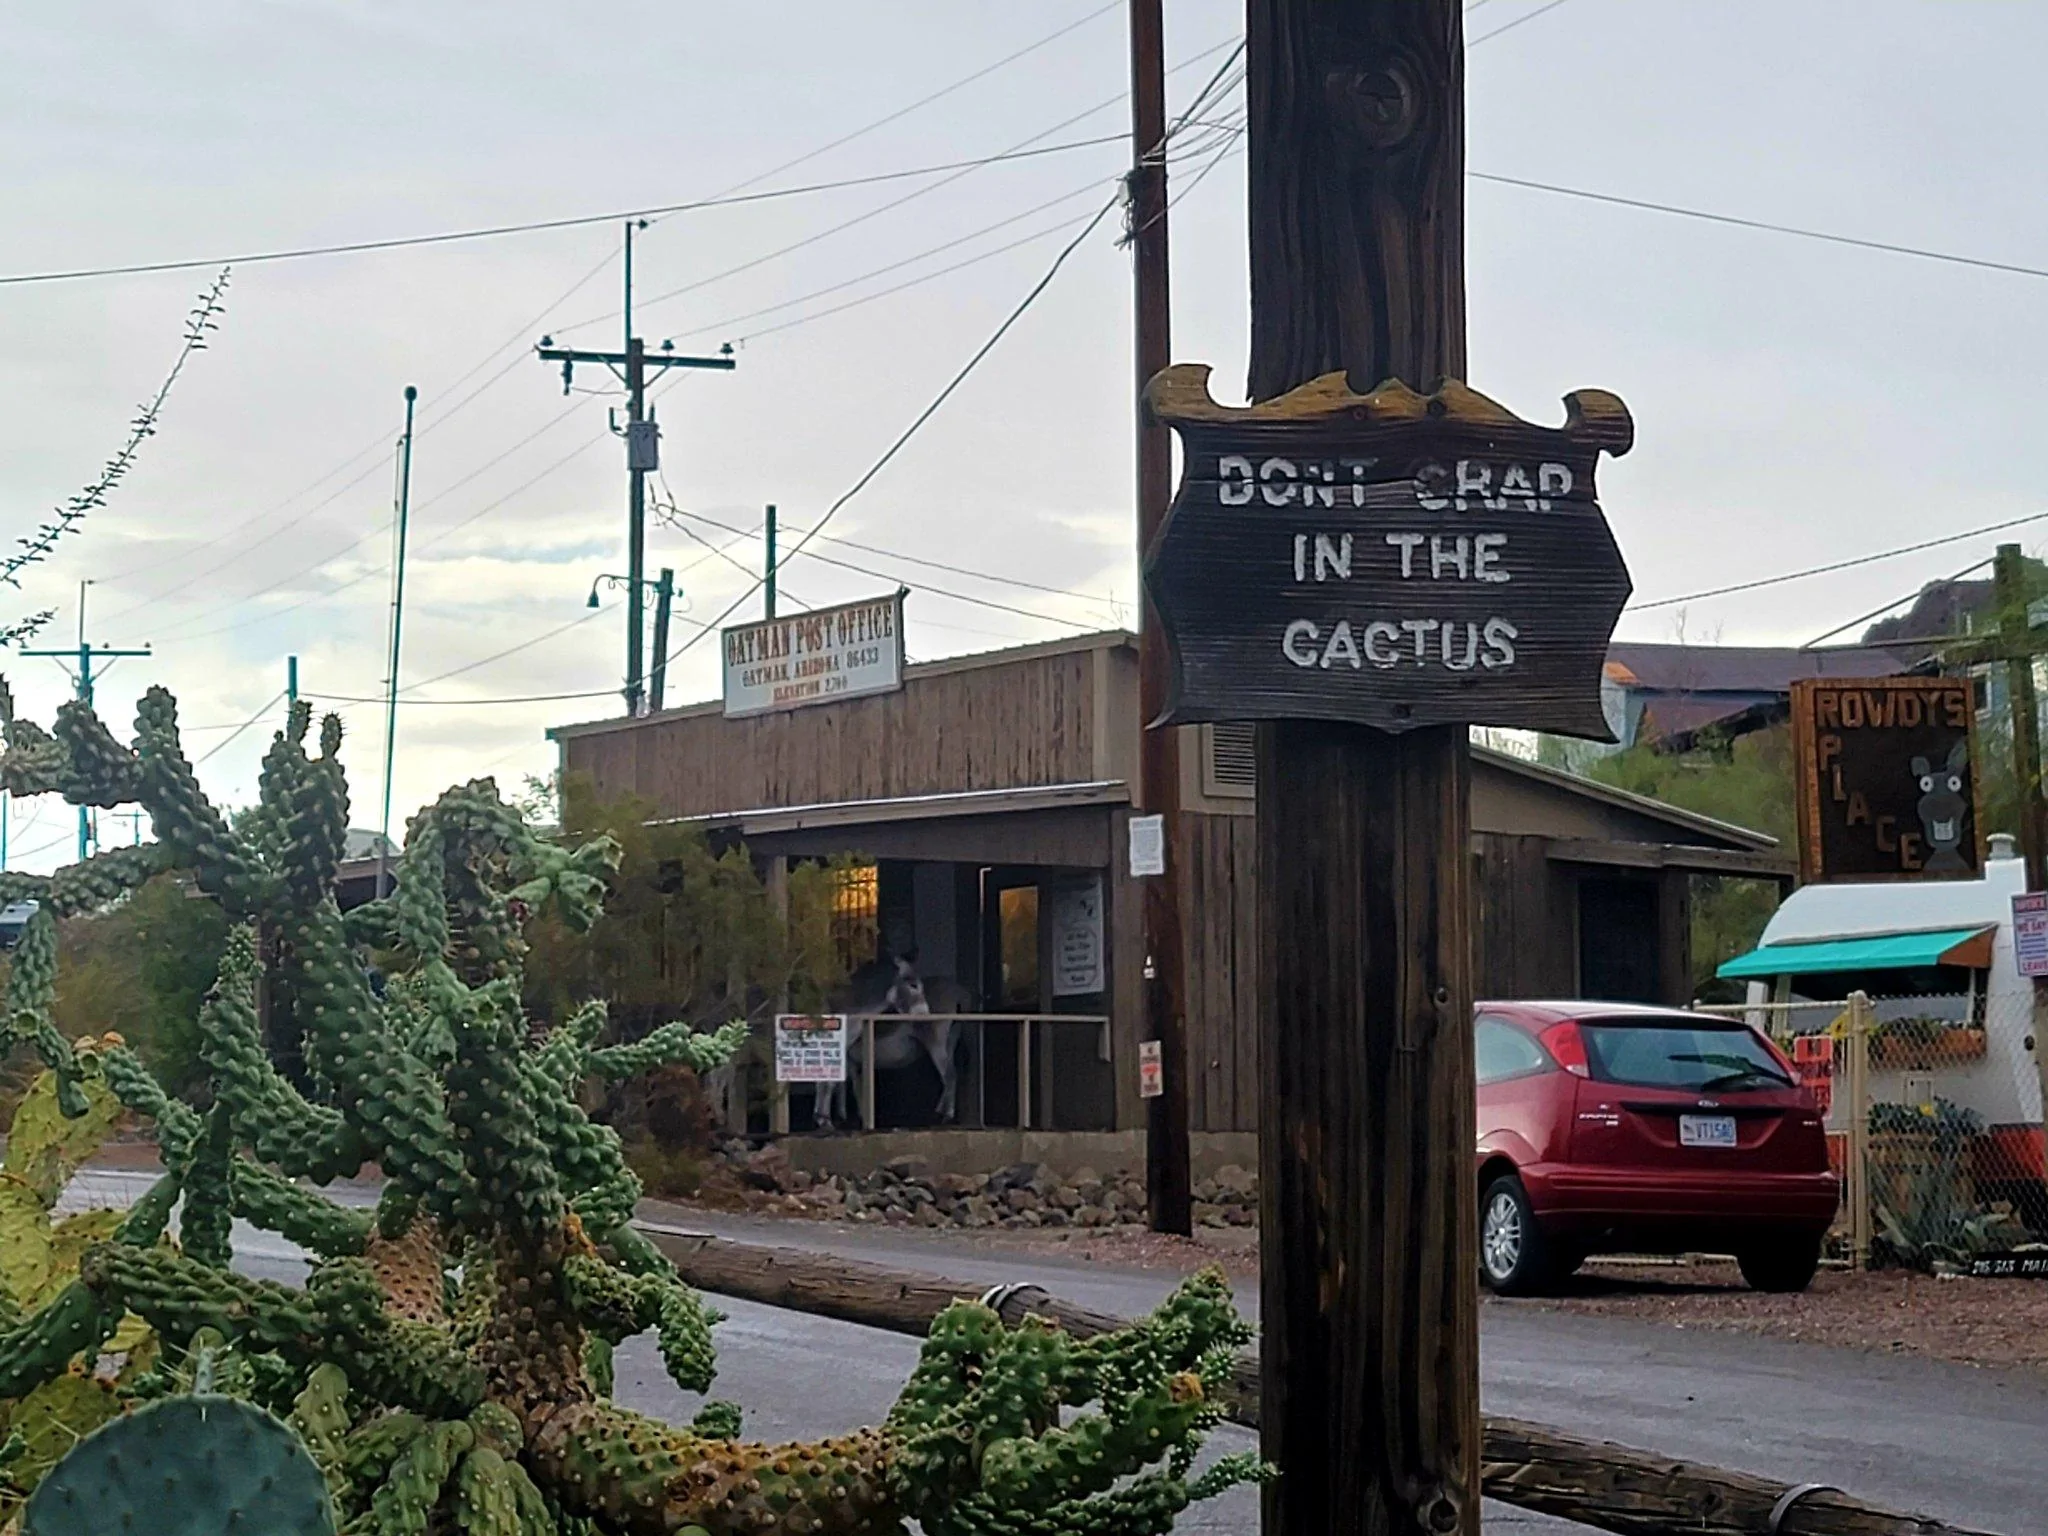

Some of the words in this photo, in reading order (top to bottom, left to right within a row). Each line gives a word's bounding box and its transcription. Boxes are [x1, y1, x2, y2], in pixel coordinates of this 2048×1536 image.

[1413, 459, 1573, 512] CRAP
[1294, 532, 1353, 582] IN
[1386, 532, 1511, 582] THE
[727, 622, 791, 667] OATMAN
[796, 617, 834, 654] POST
[837, 604, 892, 646] OFFICE
[1282, 617, 1518, 670] CACTUS
[794, 655, 840, 679] ARIZONA
[1816, 690, 1966, 728] ROWDYS
[1818, 735, 1923, 870] PLACE
